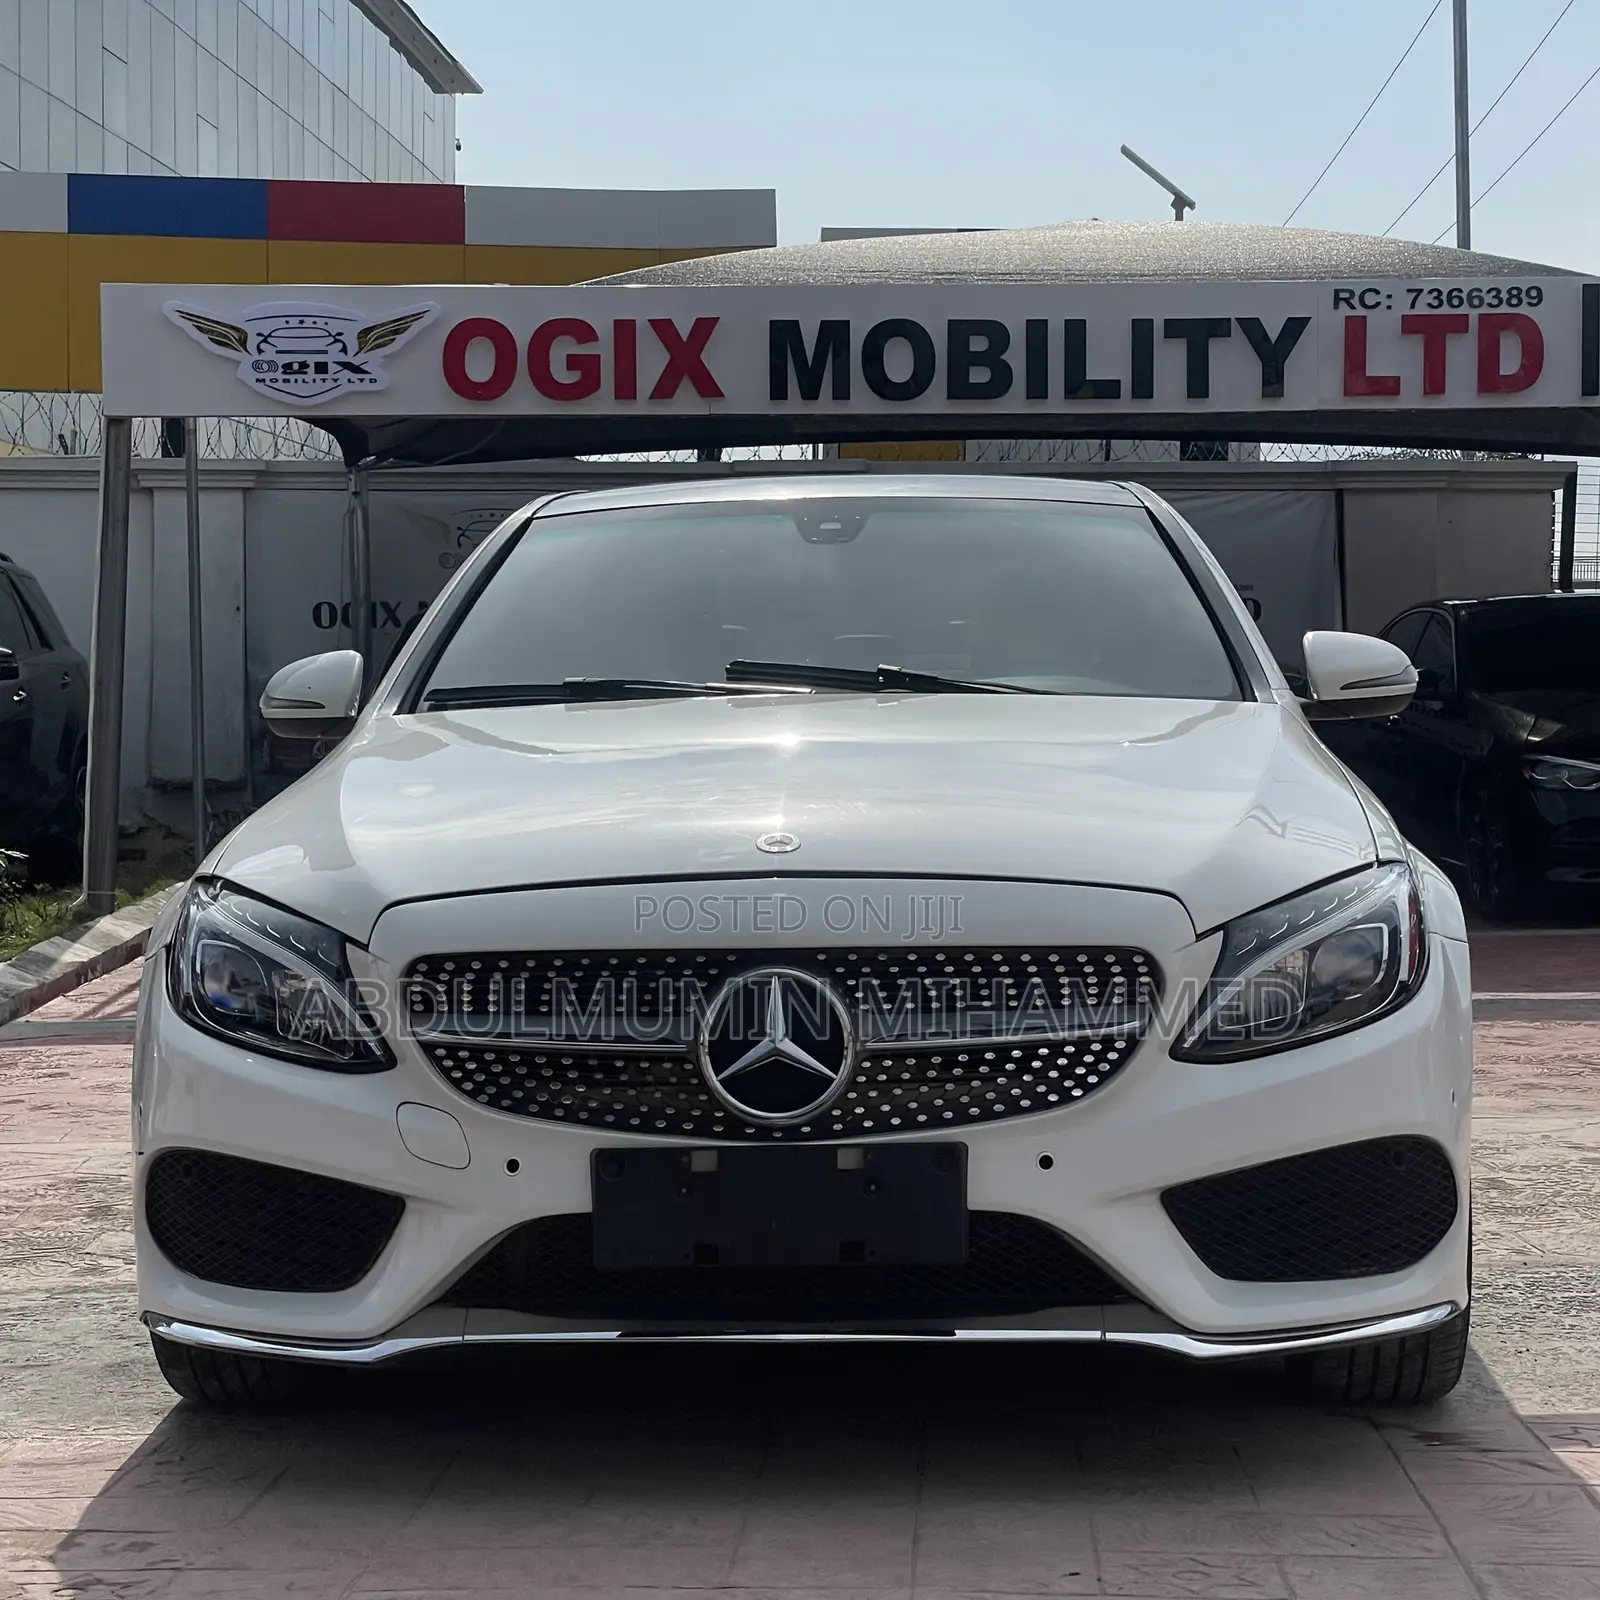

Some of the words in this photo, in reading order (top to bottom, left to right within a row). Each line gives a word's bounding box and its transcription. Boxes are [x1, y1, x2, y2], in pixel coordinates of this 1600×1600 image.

[1333, 288, 1393, 310] RC:
[1406, 286, 1544, 309] 7366389
[442, 317, 725, 401] OGIX
[769, 317, 1312, 401] MOBILITY
[1343, 313, 1545, 397] LTD
